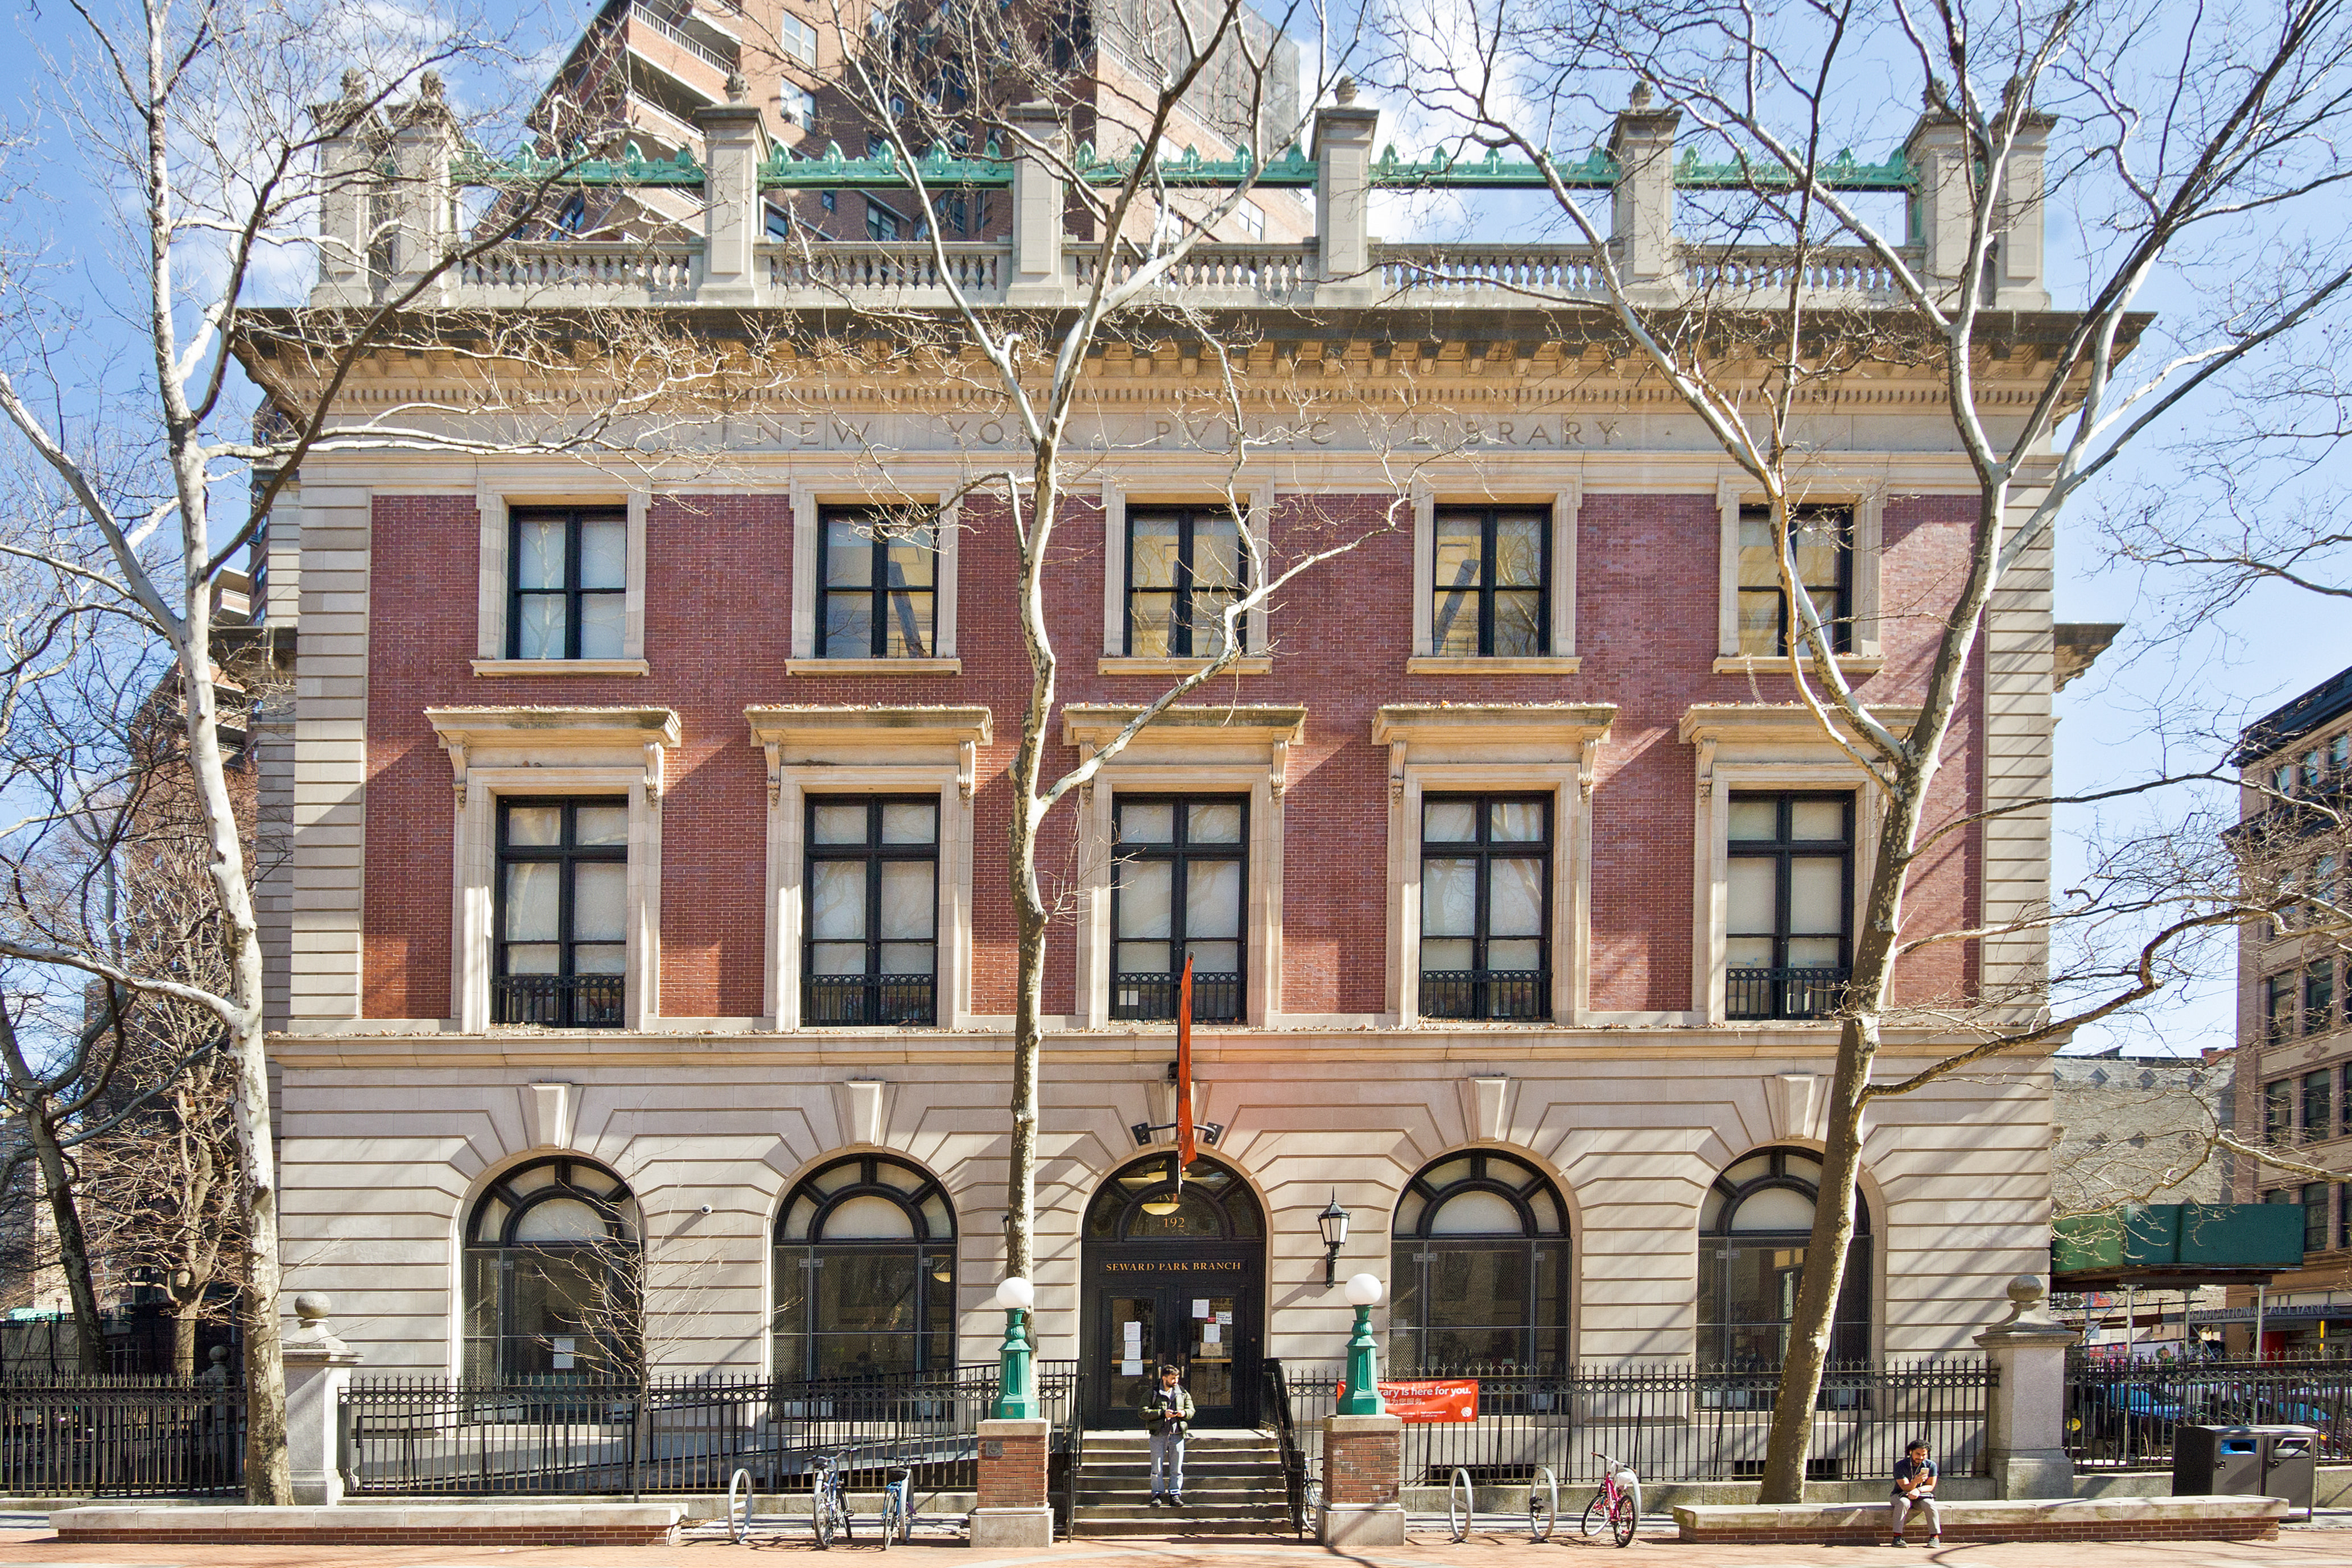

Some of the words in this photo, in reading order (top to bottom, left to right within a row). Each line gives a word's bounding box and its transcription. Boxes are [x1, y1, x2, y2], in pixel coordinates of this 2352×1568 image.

[757, 421, 870, 444] NEW
[947, 420, 1074, 445] YOK
[1412, 420, 1619, 445] LIBRARY
[1163, 1217, 1185, 1228] 192
[2192, 1306, 2265, 1321] EDUCATIONA
[2269, 1304, 2339, 1316] ALLIANCE
[1379, 1389, 1400, 1398] rary
[1401, 1387, 1409, 1396] is
[1411, 1387, 1433, 1396] here
[1435, 1386, 1449, 1395] for
[1450, 1387, 1471, 1397] you.
